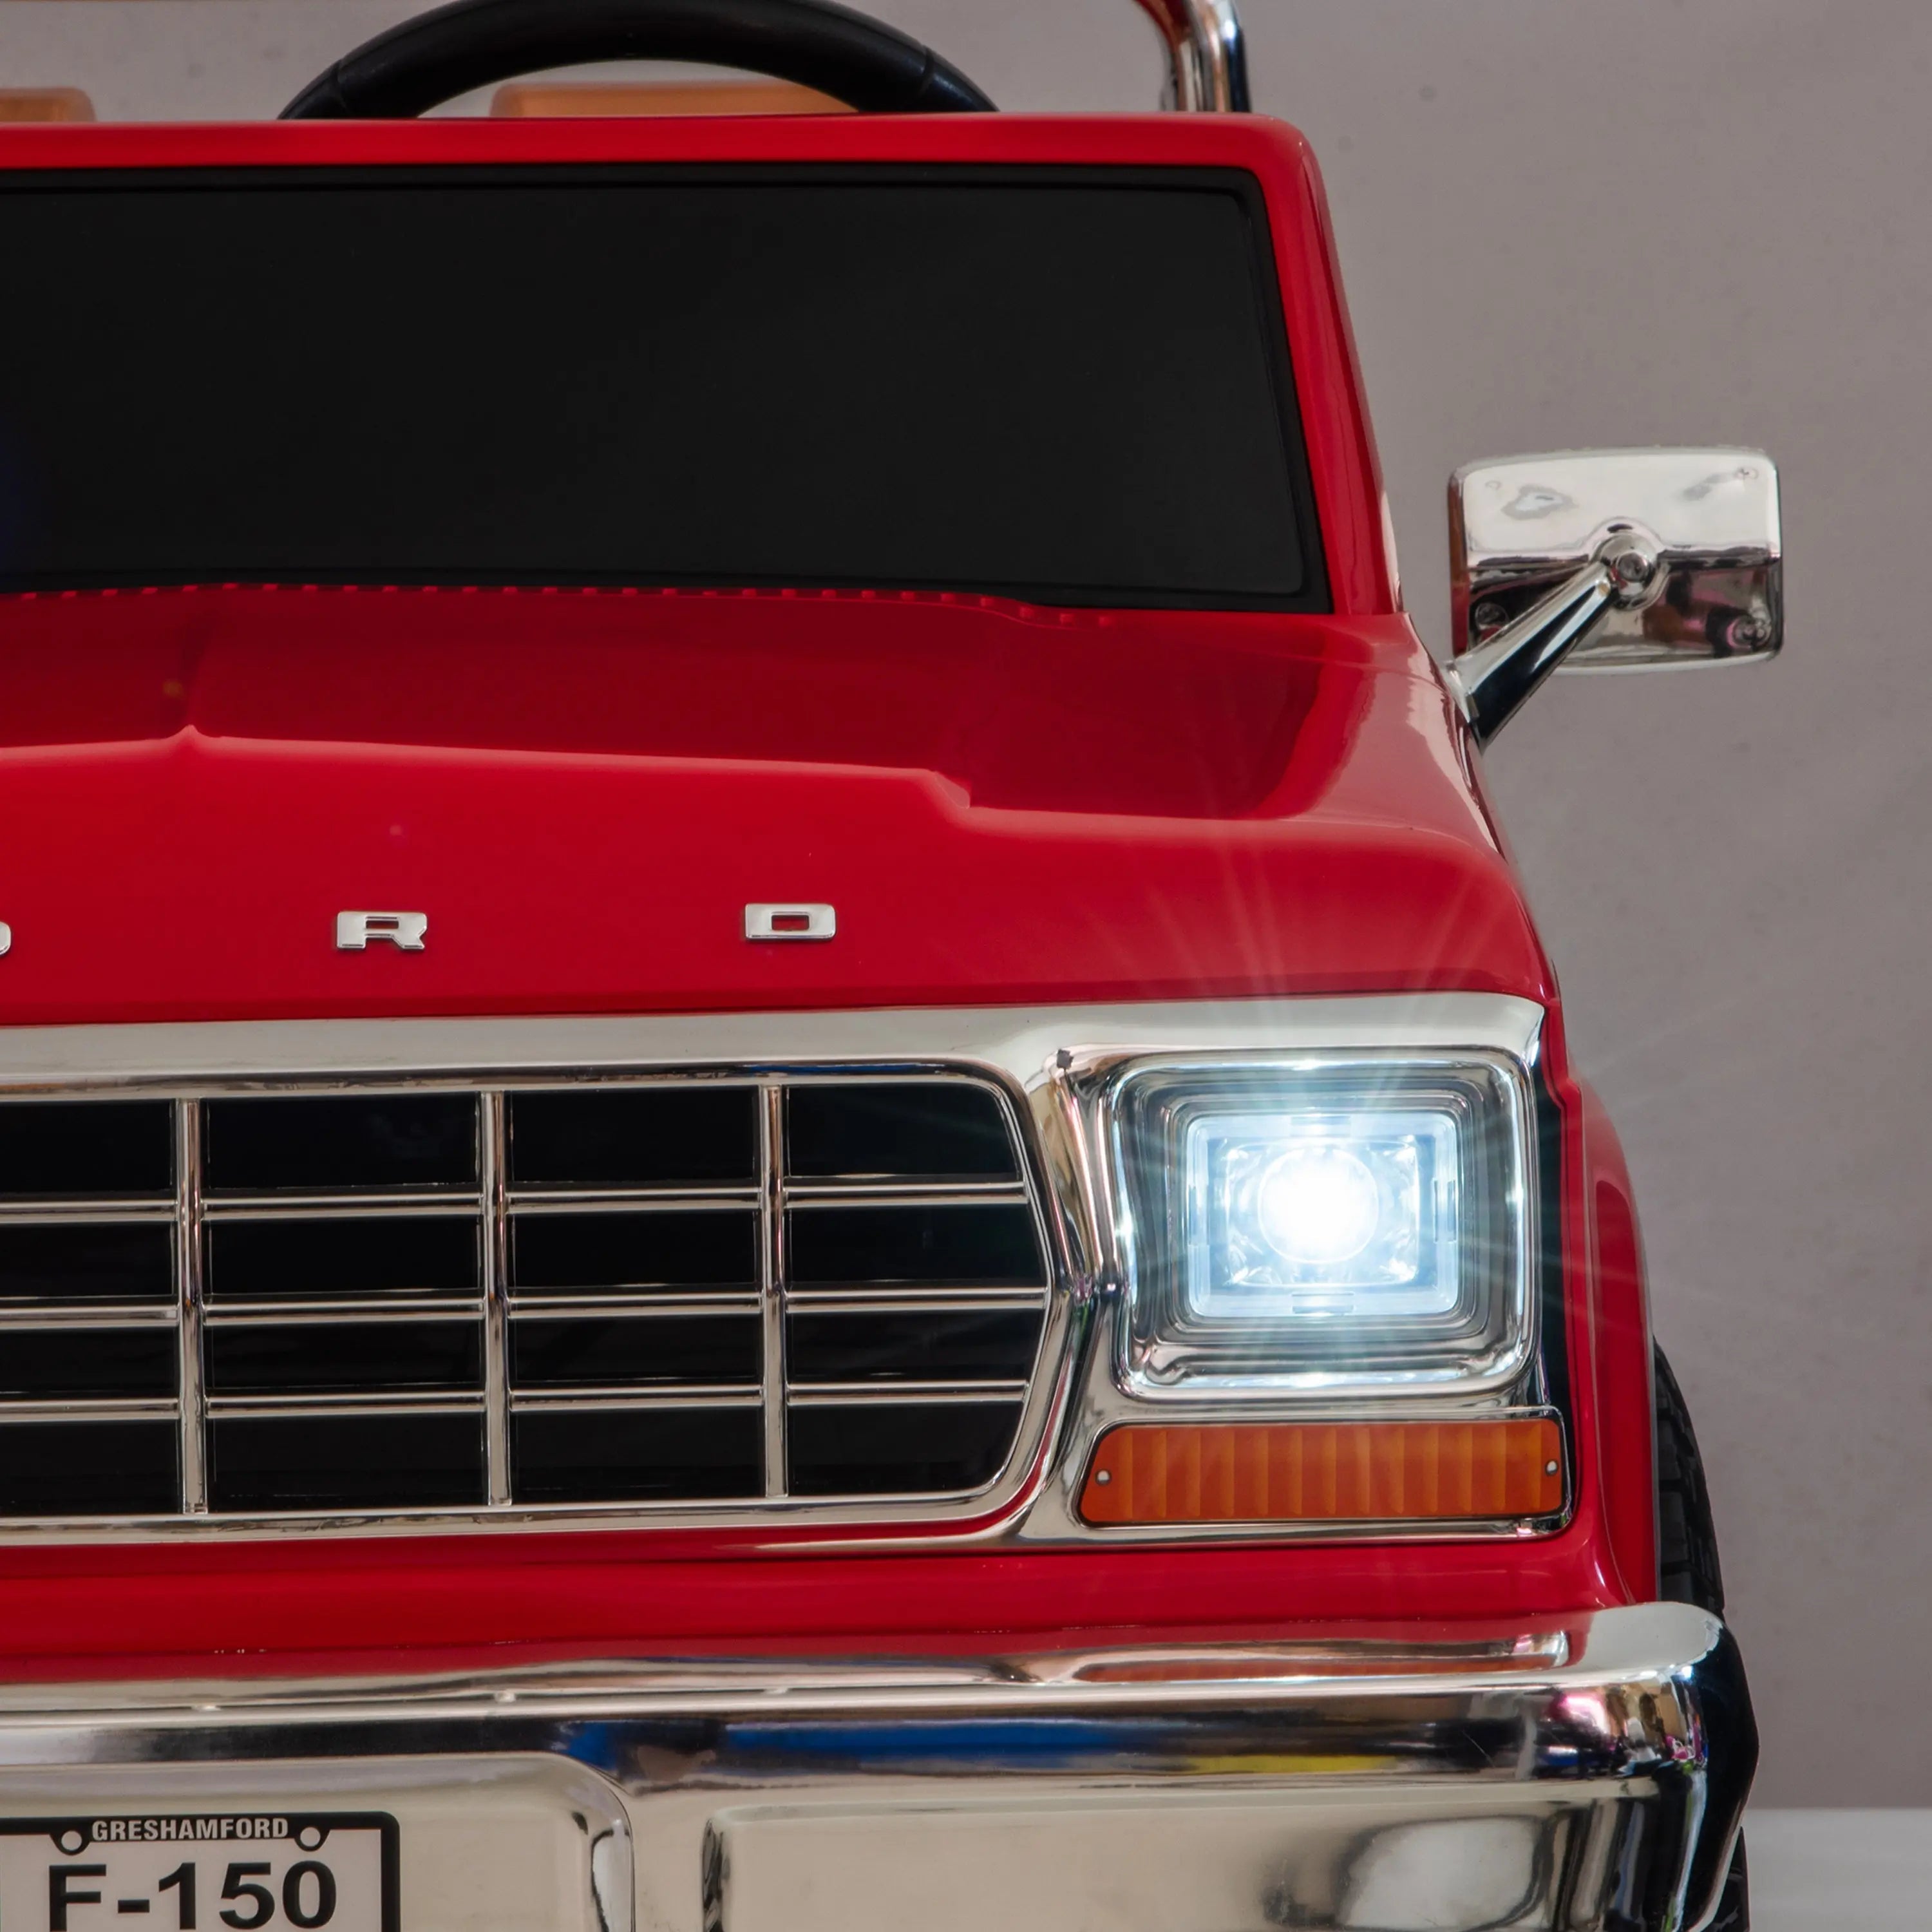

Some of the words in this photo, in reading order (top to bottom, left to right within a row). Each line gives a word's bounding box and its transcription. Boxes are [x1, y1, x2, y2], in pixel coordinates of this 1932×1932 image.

[0, 903, 837, 955] RD
[92, 1818, 289, 1842] GRESHAMFORD
[49, 1861, 337, 1932] F-150
